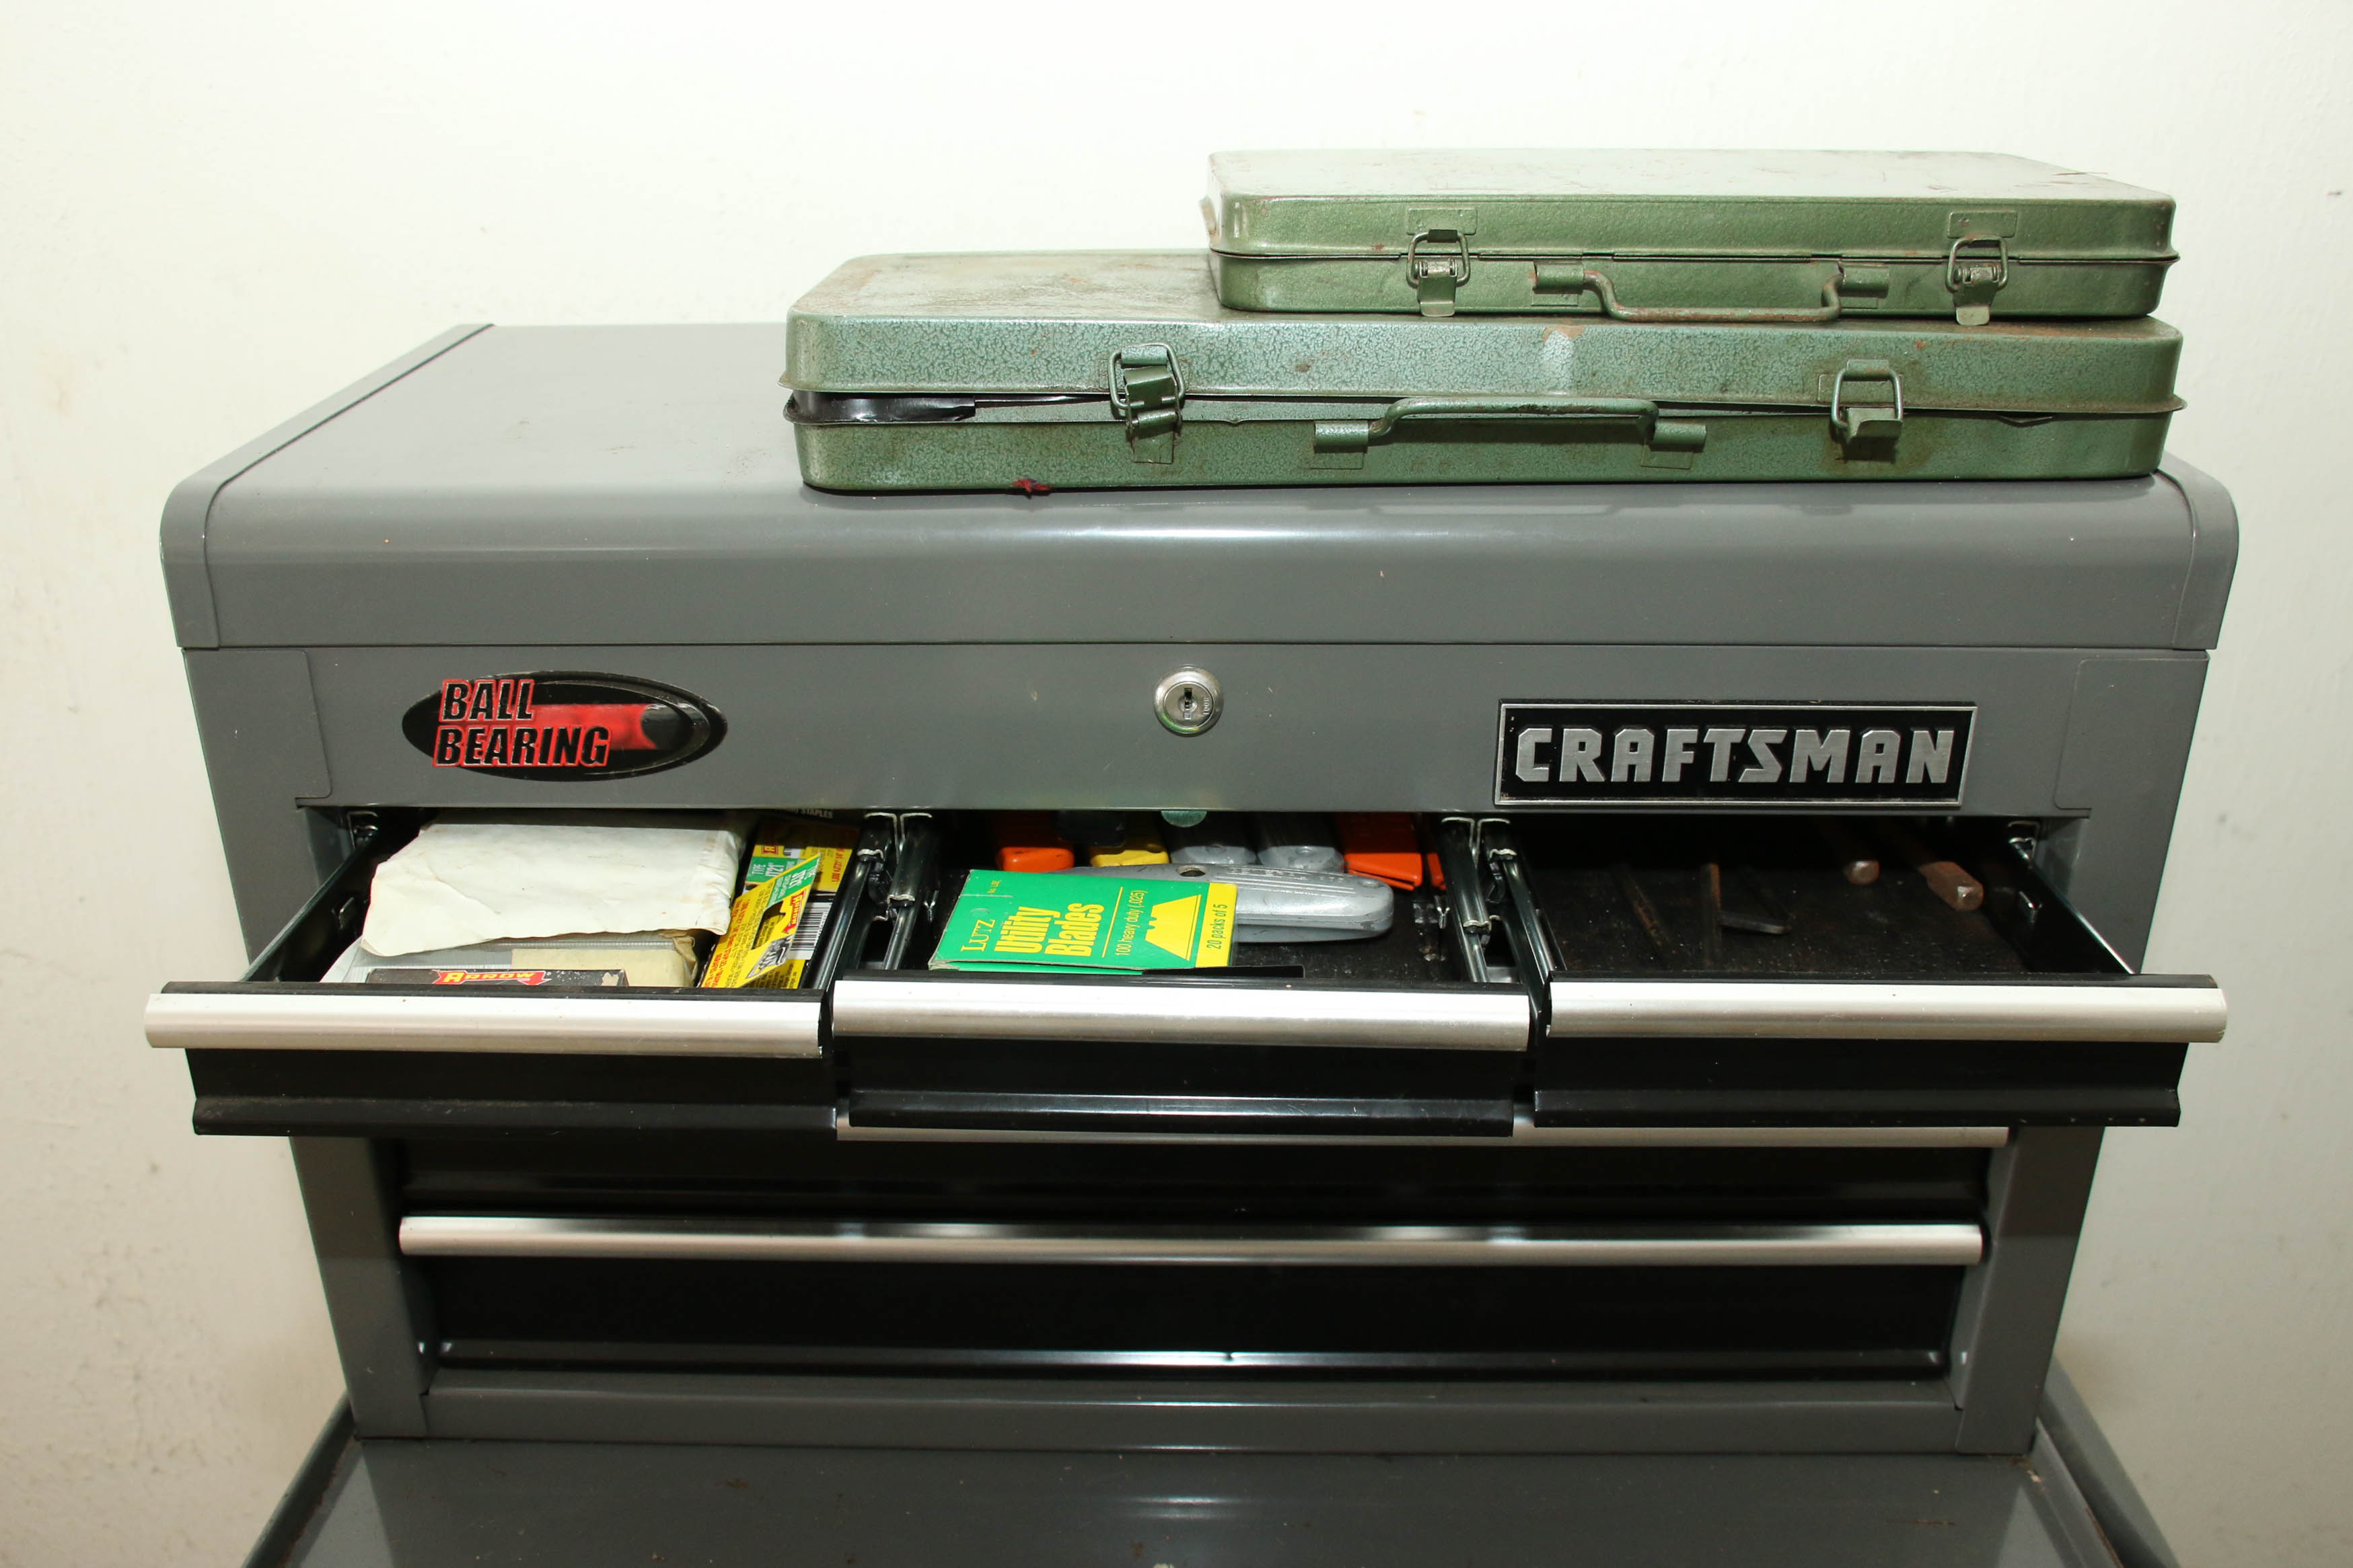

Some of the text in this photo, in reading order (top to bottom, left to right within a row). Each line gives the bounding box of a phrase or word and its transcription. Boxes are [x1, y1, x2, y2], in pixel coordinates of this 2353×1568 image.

[440, 680, 535, 722] BALL
[435, 726, 610, 767] BEARING
[1515, 727, 1955, 784] CRAFTSMAN
[752, 864, 766, 875] TYPE
[994, 906, 1061, 953] Utility
[1044, 903, 1105, 957] Blades
[1115, 889, 1149, 956] 100 heavy duty (.025)
[1210, 919, 1228, 939] packs
[1212, 907, 1227, 918] of
[960, 919, 996, 952] LUTZ
[1206, 940, 1222, 950] 20
[443, 972, 536, 983] ARROW
